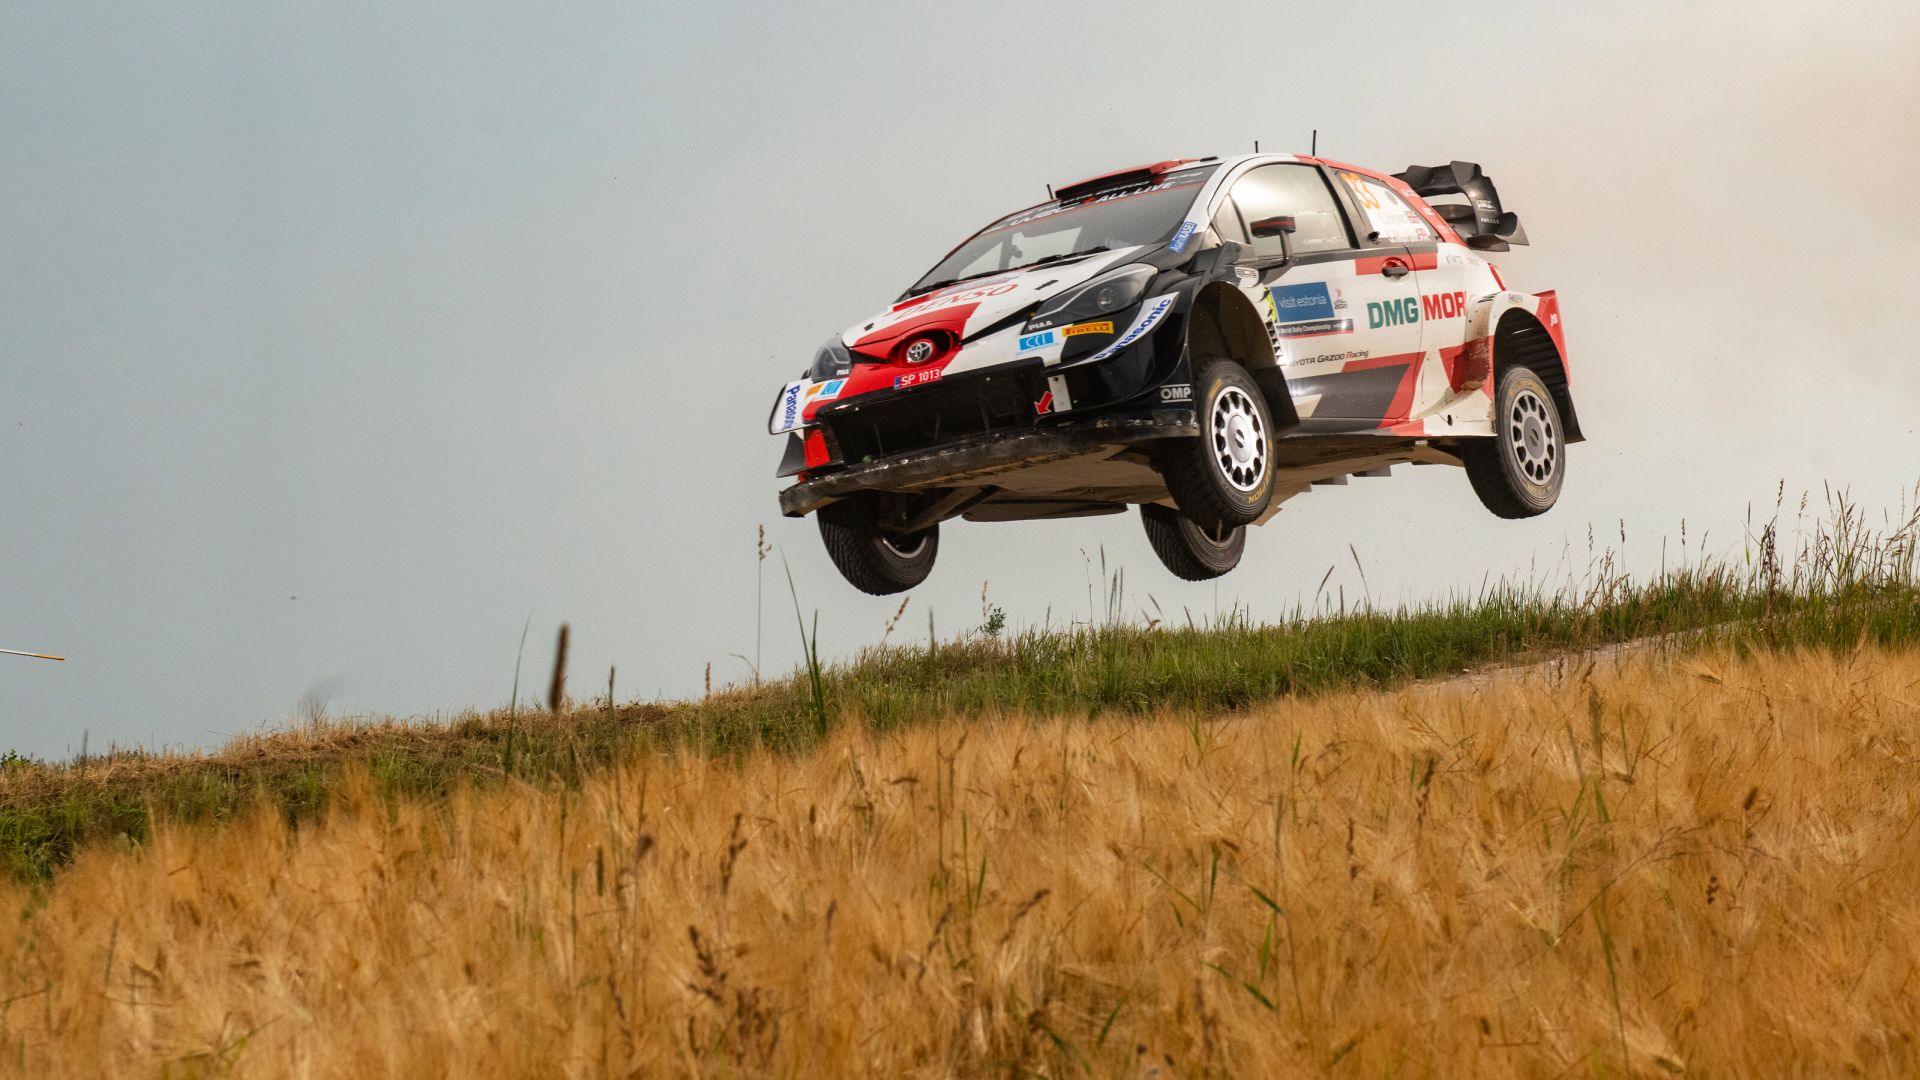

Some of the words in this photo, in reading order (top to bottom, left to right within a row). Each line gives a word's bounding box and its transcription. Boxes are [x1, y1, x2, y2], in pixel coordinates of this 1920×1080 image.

[1095, 189, 1127, 203] ALL
[1133, 181, 1175, 195] LIVE
[1340, 172, 1380, 209] 33
[1278, 297, 1297, 309] visit
[1297, 294, 1328, 307] estonia
[1367, 297, 1419, 329] DMG
[1422, 290, 1467, 321] MOR
[1029, 320, 1053, 331] PIAA
[1065, 322, 1110, 336] PIRELLI
[1094, 299, 1171, 360] Panasonic
[1346, 350, 1369, 359] Racing
[901, 374, 915, 386] SP
[918, 368, 941, 382] 1013
[1160, 386, 1192, 400] OMP
